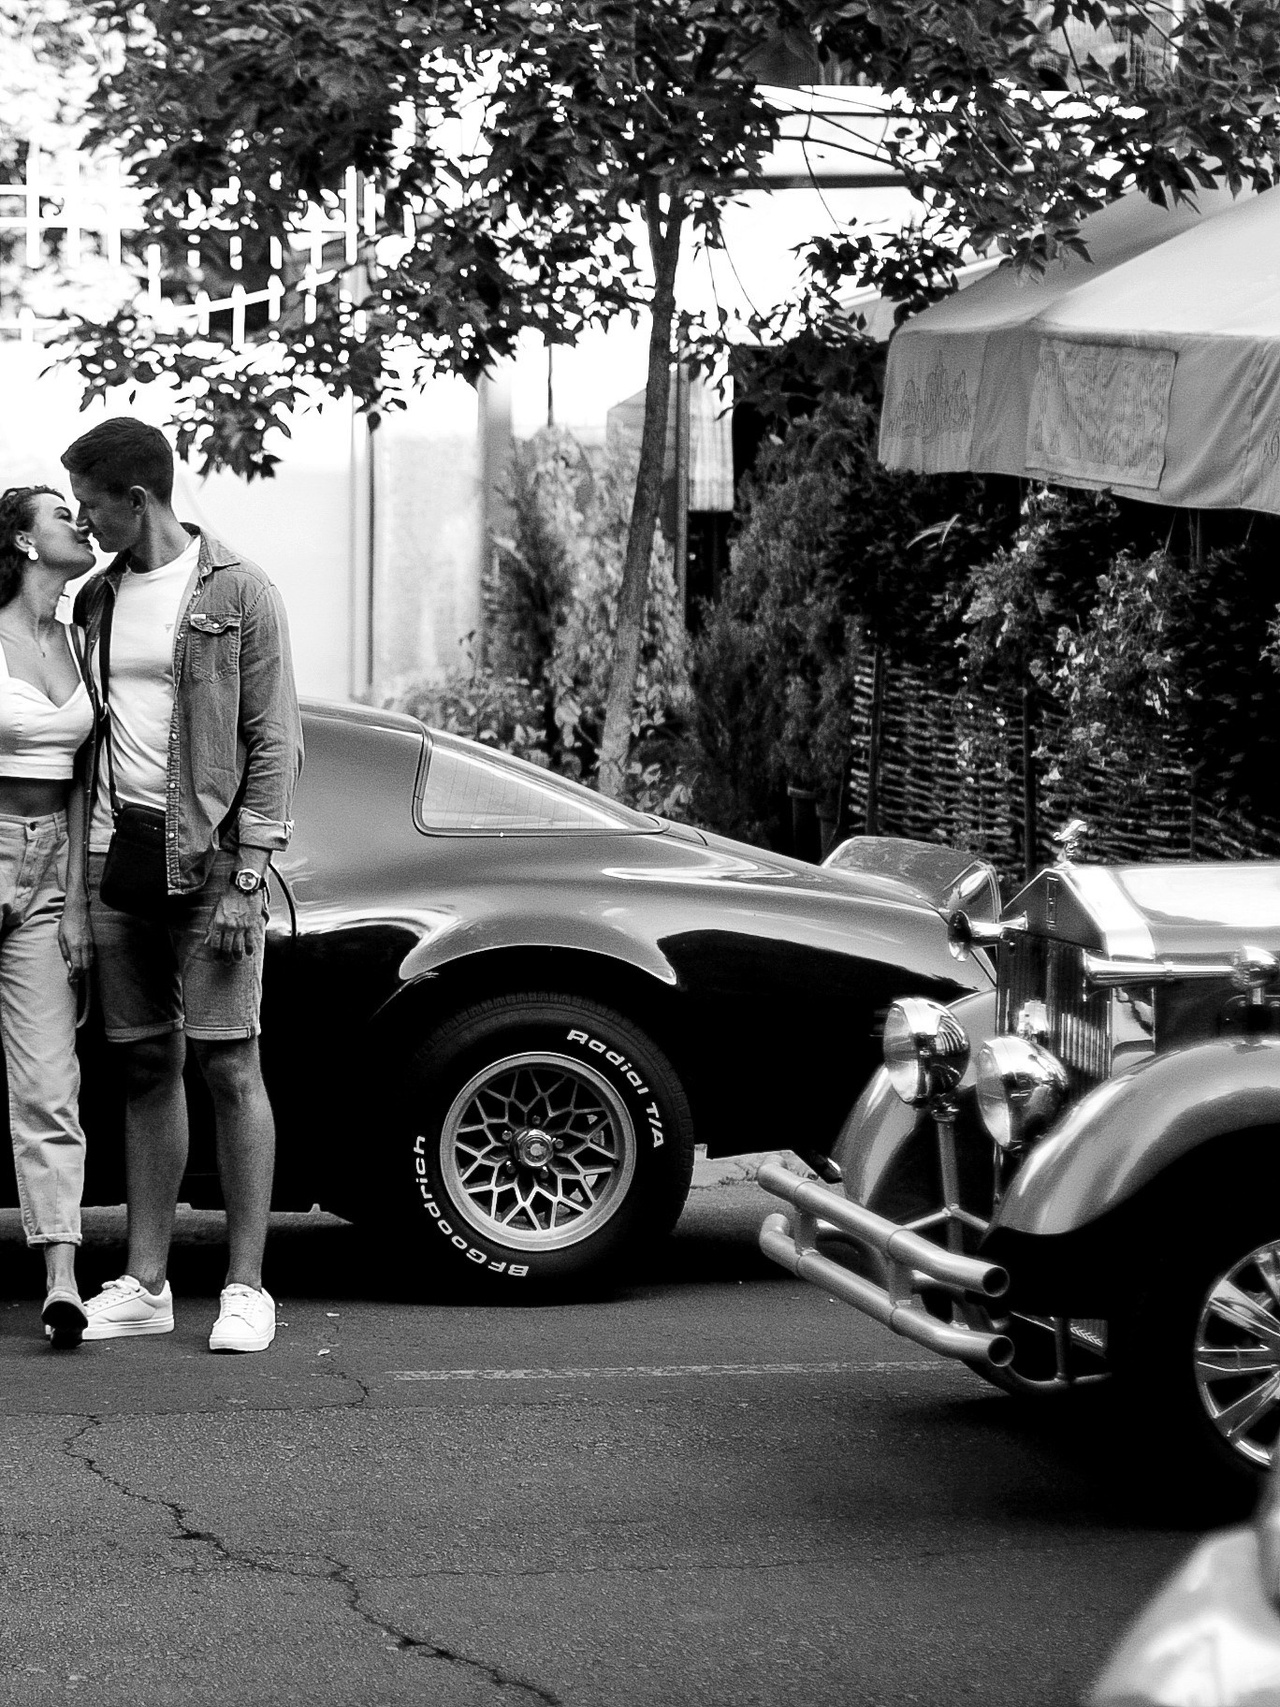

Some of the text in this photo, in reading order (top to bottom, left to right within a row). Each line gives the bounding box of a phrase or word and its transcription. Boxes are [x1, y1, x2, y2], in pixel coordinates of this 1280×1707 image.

[566, 1029, 664, 1147] Radial T/A
[413, 1135, 530, 1277] BFGoodrich
